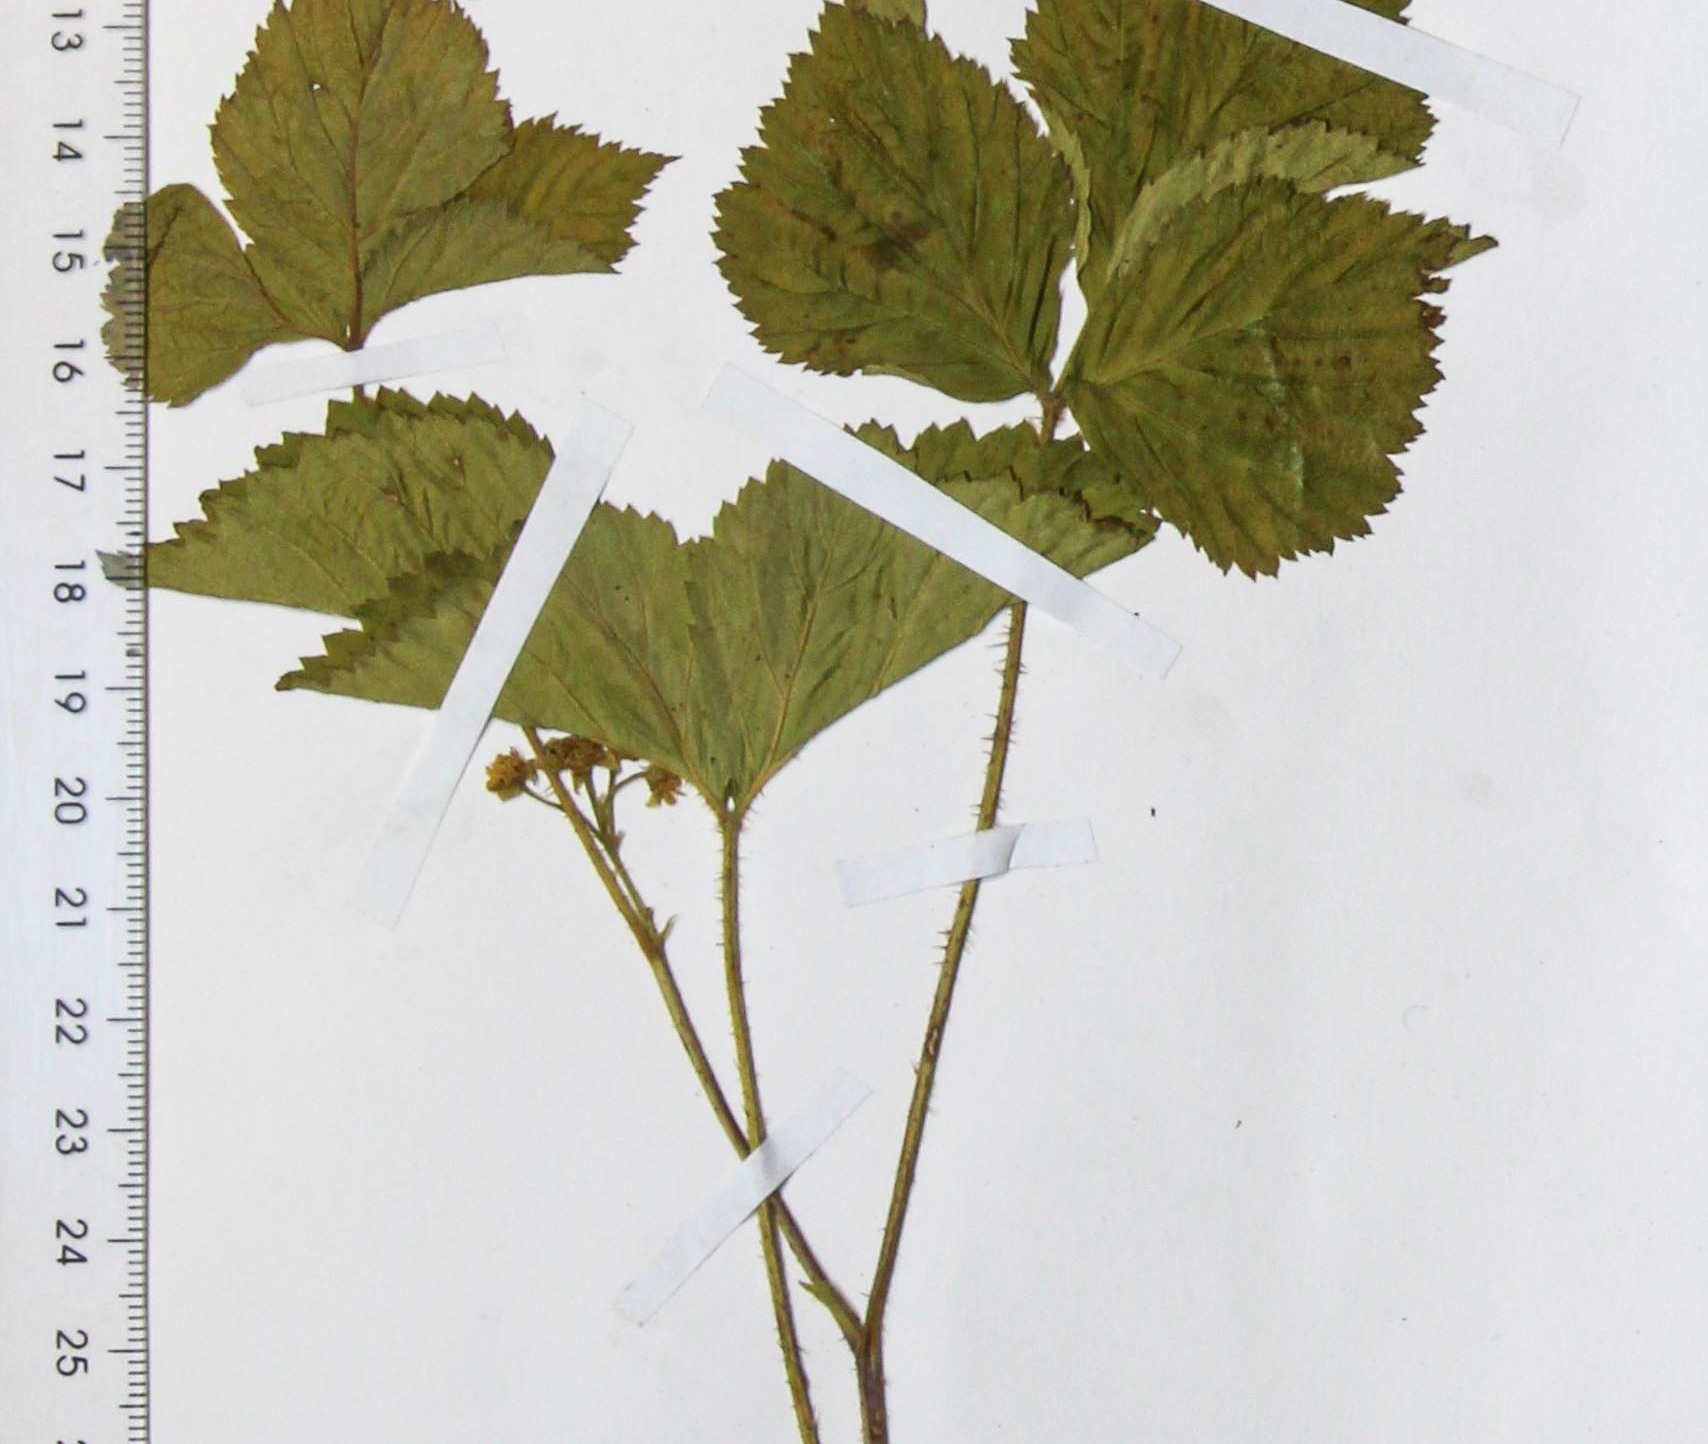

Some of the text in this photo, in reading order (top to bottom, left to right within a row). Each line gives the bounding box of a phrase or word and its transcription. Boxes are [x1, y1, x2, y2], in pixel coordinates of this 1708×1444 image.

[51, 9, 85, 52] 13
[52, 119, 84, 162] 14
[52, 229, 86, 273] 15
[52, 339, 86, 383] 16
[53, 450, 86, 492] 17
[53, 560, 87, 603] 18
[54, 670, 87, 714] 19
[54, 777, 88, 825] 20
[55, 888, 88, 927] 21
[55, 998, 89, 1045] 22
[55, 1109, 89, 1156] 23
[56, 1219, 88, 1266] 24
[56, 1329, 88, 1376] 25
